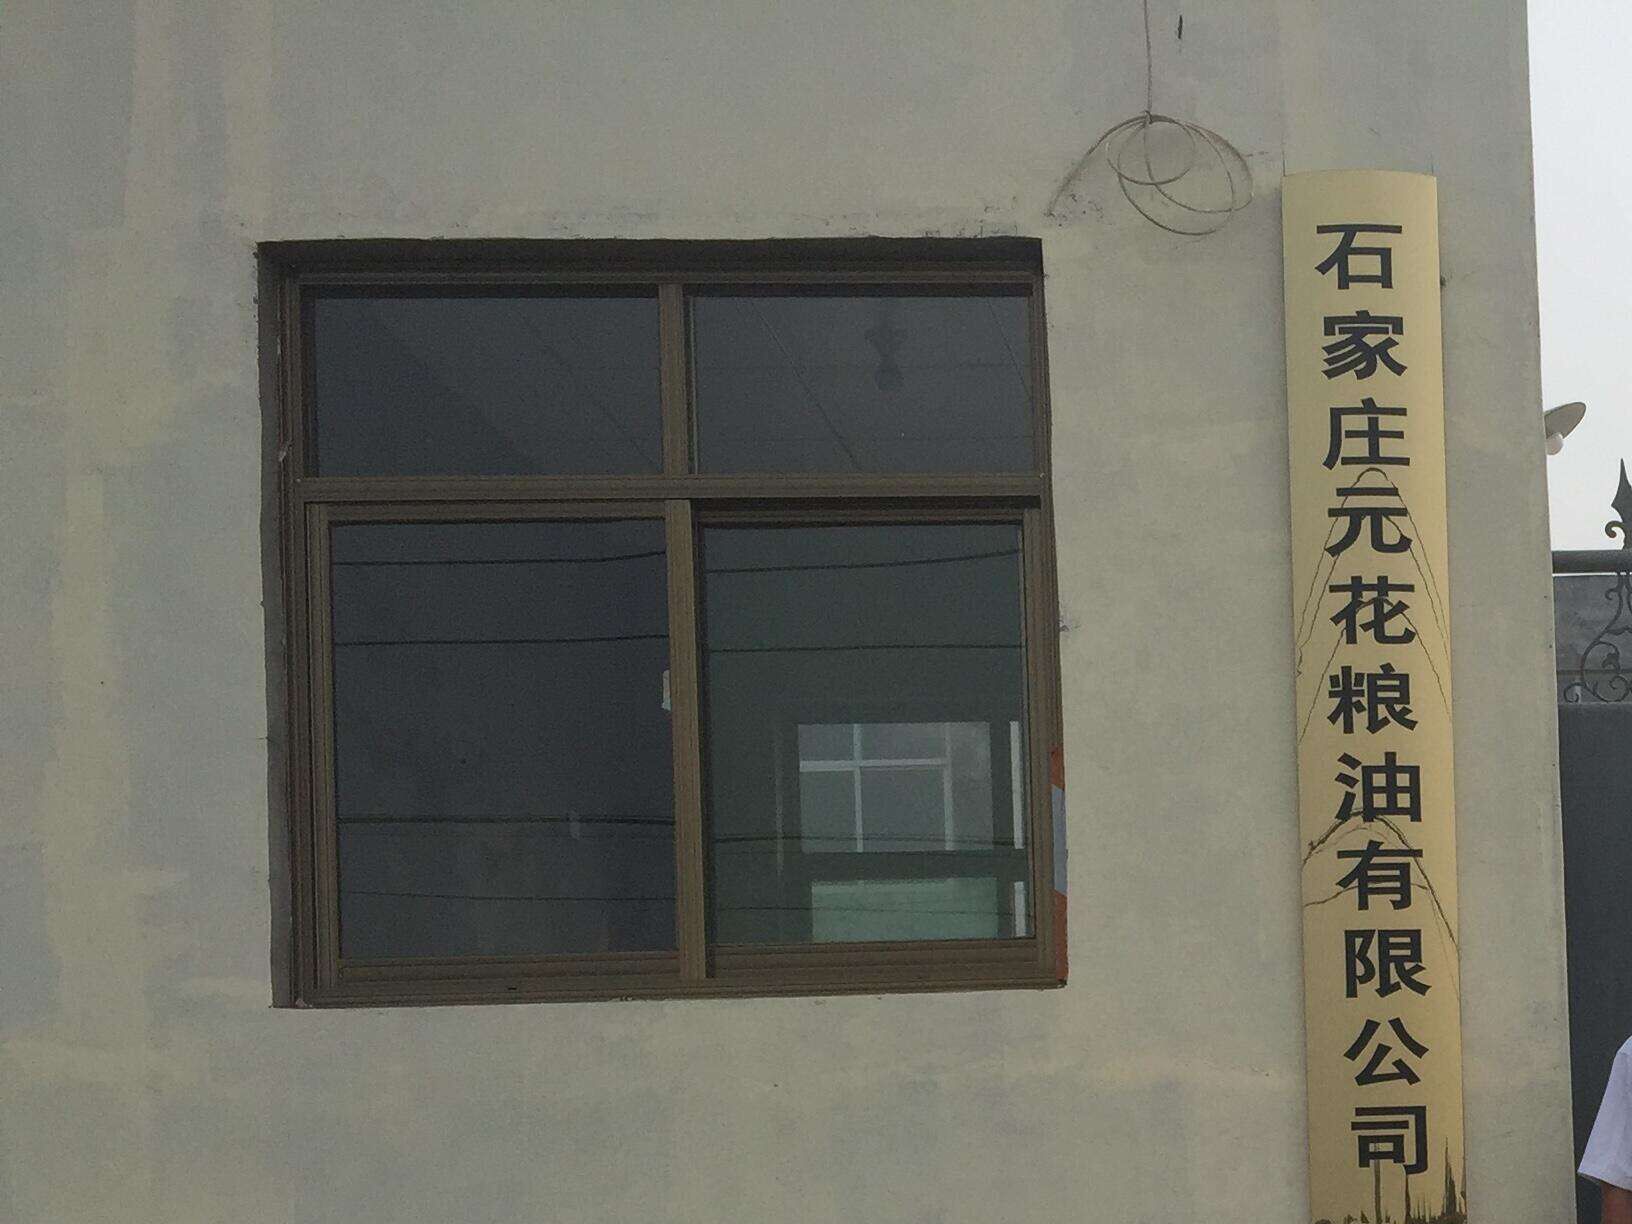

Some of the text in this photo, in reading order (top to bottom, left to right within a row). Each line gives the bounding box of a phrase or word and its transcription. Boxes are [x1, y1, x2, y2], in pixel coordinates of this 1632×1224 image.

[1314, 223, 1432, 1176] 石家庄元花粮油有限公司
